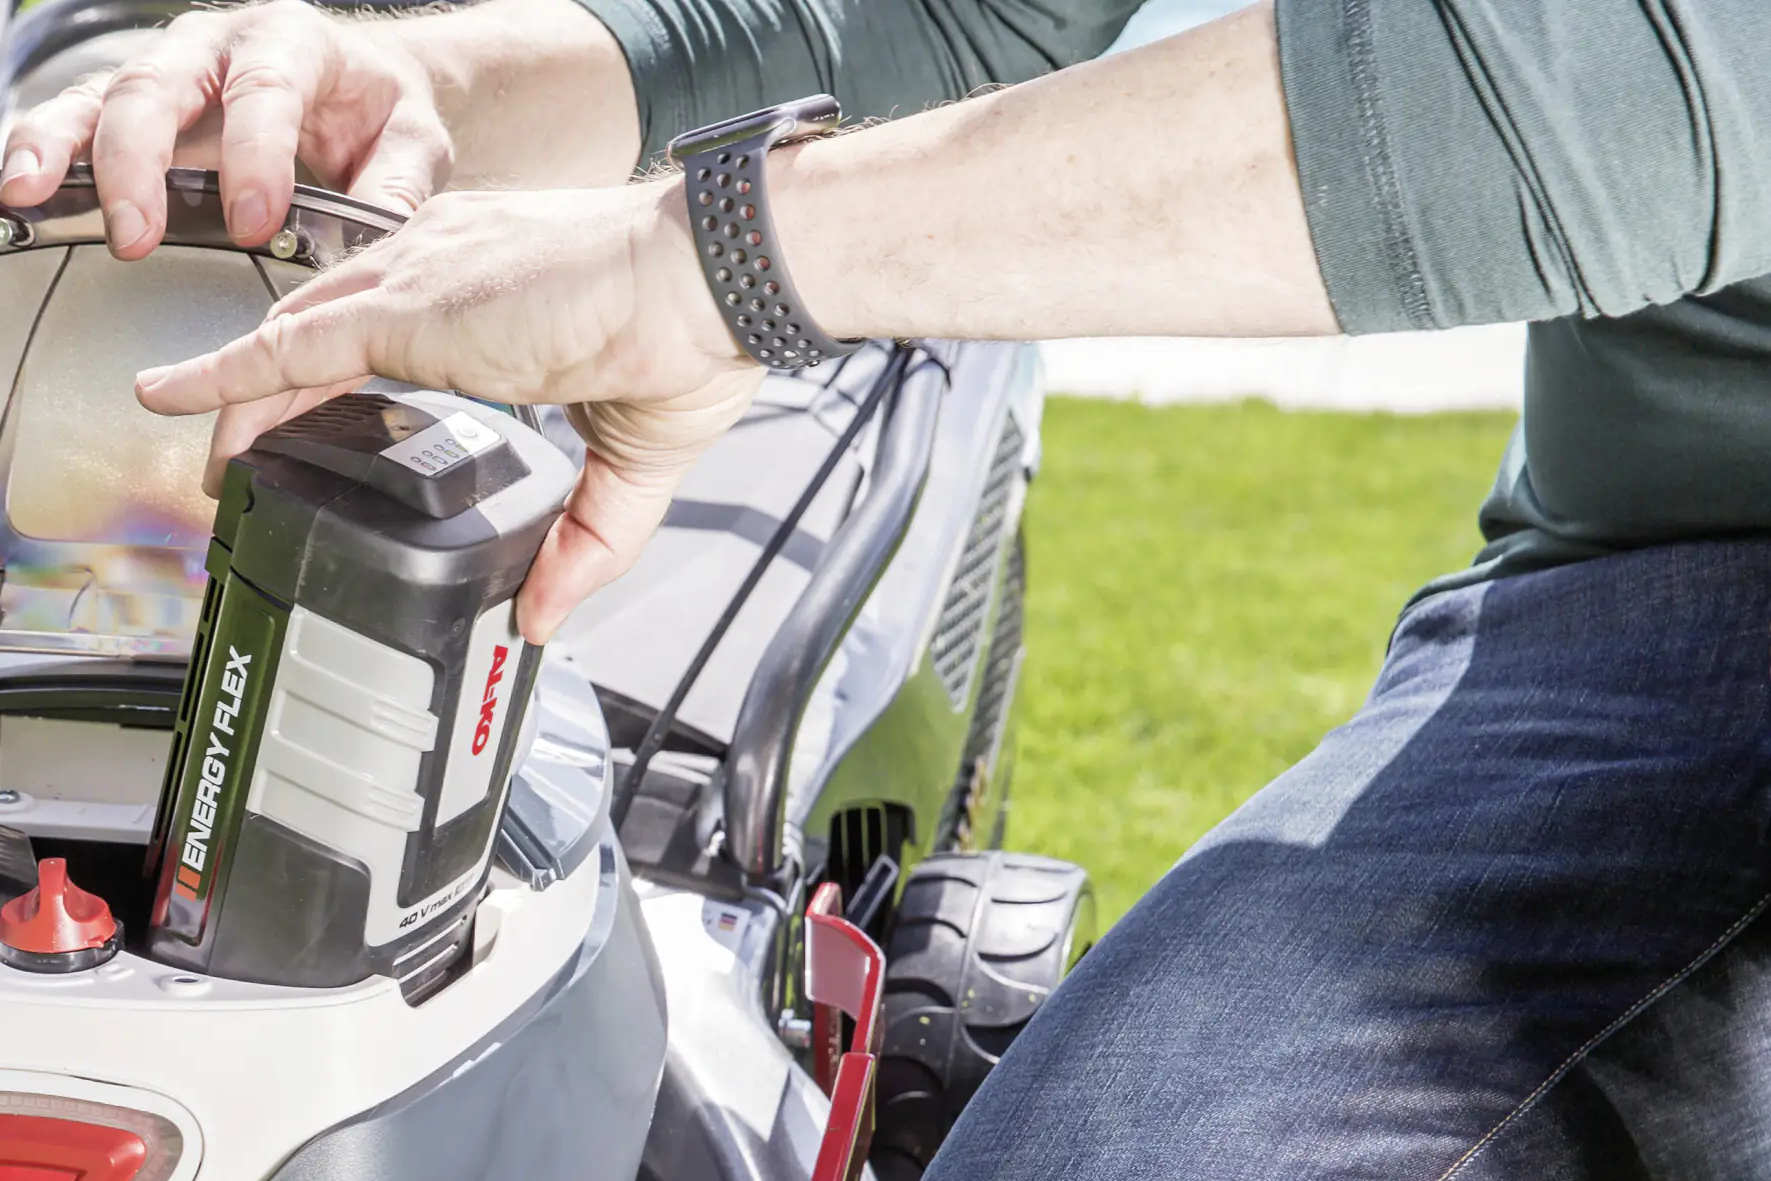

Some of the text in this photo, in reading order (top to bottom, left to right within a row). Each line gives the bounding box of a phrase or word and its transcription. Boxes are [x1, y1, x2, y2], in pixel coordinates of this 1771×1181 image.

[472, 645, 508, 756] AL-KO
[181, 645, 252, 872] ENERGY FLEX
[399, 911, 418, 928] 40
[421, 904, 429, 918] V
